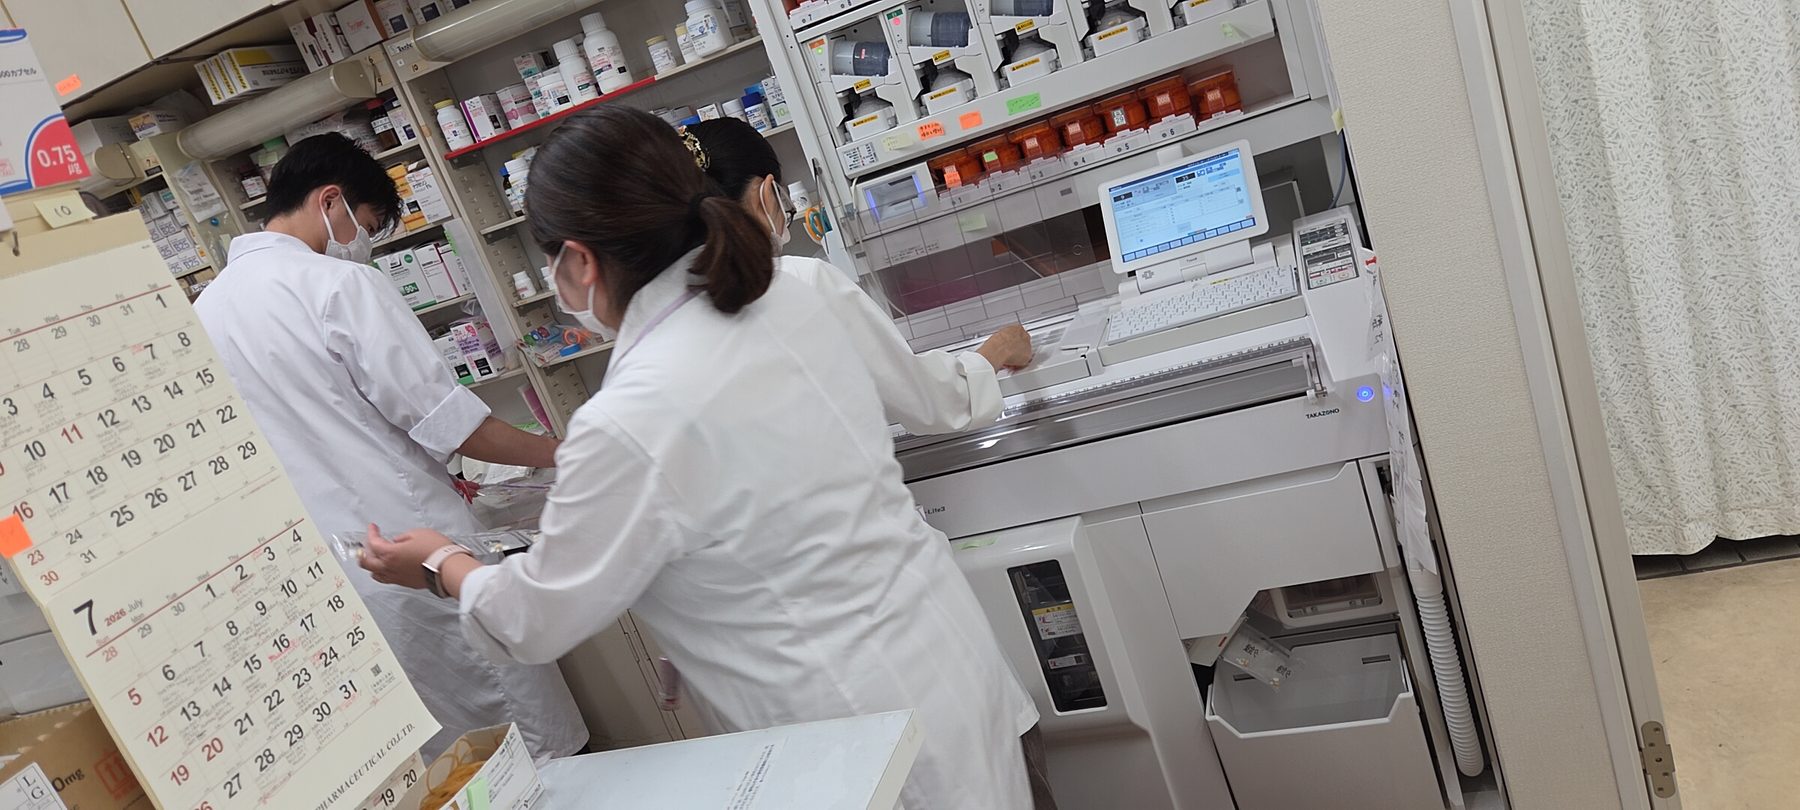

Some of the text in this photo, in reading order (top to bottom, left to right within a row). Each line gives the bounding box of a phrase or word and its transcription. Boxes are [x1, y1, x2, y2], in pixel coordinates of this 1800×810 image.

[37, 145, 77, 168] 0.75
[13, 293, 167, 353] 28 29 30 31 1
[43, 314, 60, 323] Wed
[3, 331, 191, 416] 3 4 5 6 7 8
[24, 367, 215, 461] 10 11 12 13 14 15
[12, 405, 238, 522] 16 17 18 19 20 21 22
[27, 441, 258, 566] 23 24 25 26 27 28 29
[40, 548, 97, 586] 30 31
[101, 529, 302, 663] 28 29 30 1 2 3 4
[73, 598, 143, 636] 7 2026 July
[127, 561, 324, 706] 5 6 7 8 9 10 11
[147, 594, 345, 748] 12 13 14 15 16 17 18
[170, 626, 366, 787] 19 20 21 22 23 24 25
[194, 801, 213, 810] 6
[223, 772, 242, 799] 27
[254, 747, 276, 772] 28
[284, 723, 305, 747] 29
[312, 701, 332, 723] 30
[339, 679, 358, 700] 31
[380, 768, 418, 806] 19 20
